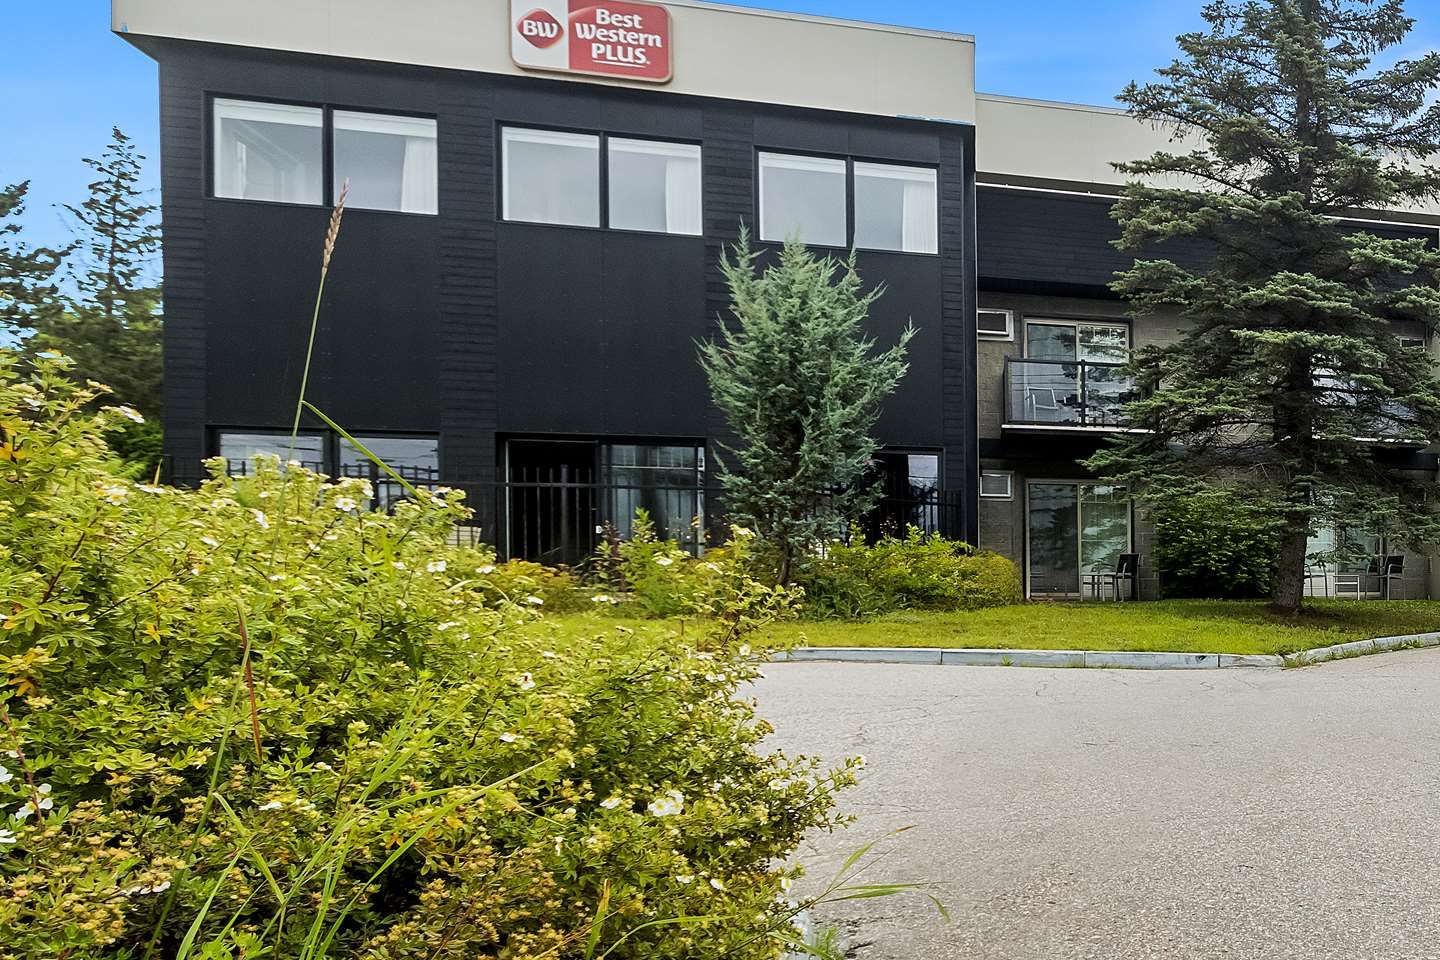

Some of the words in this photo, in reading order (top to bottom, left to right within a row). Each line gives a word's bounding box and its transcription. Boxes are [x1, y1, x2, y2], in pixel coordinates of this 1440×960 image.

[522, 19, 558, 39] BW
[595, 8, 643, 29] Best
[575, 22, 663, 48] Western
[591, 42, 647, 65] PLUS
